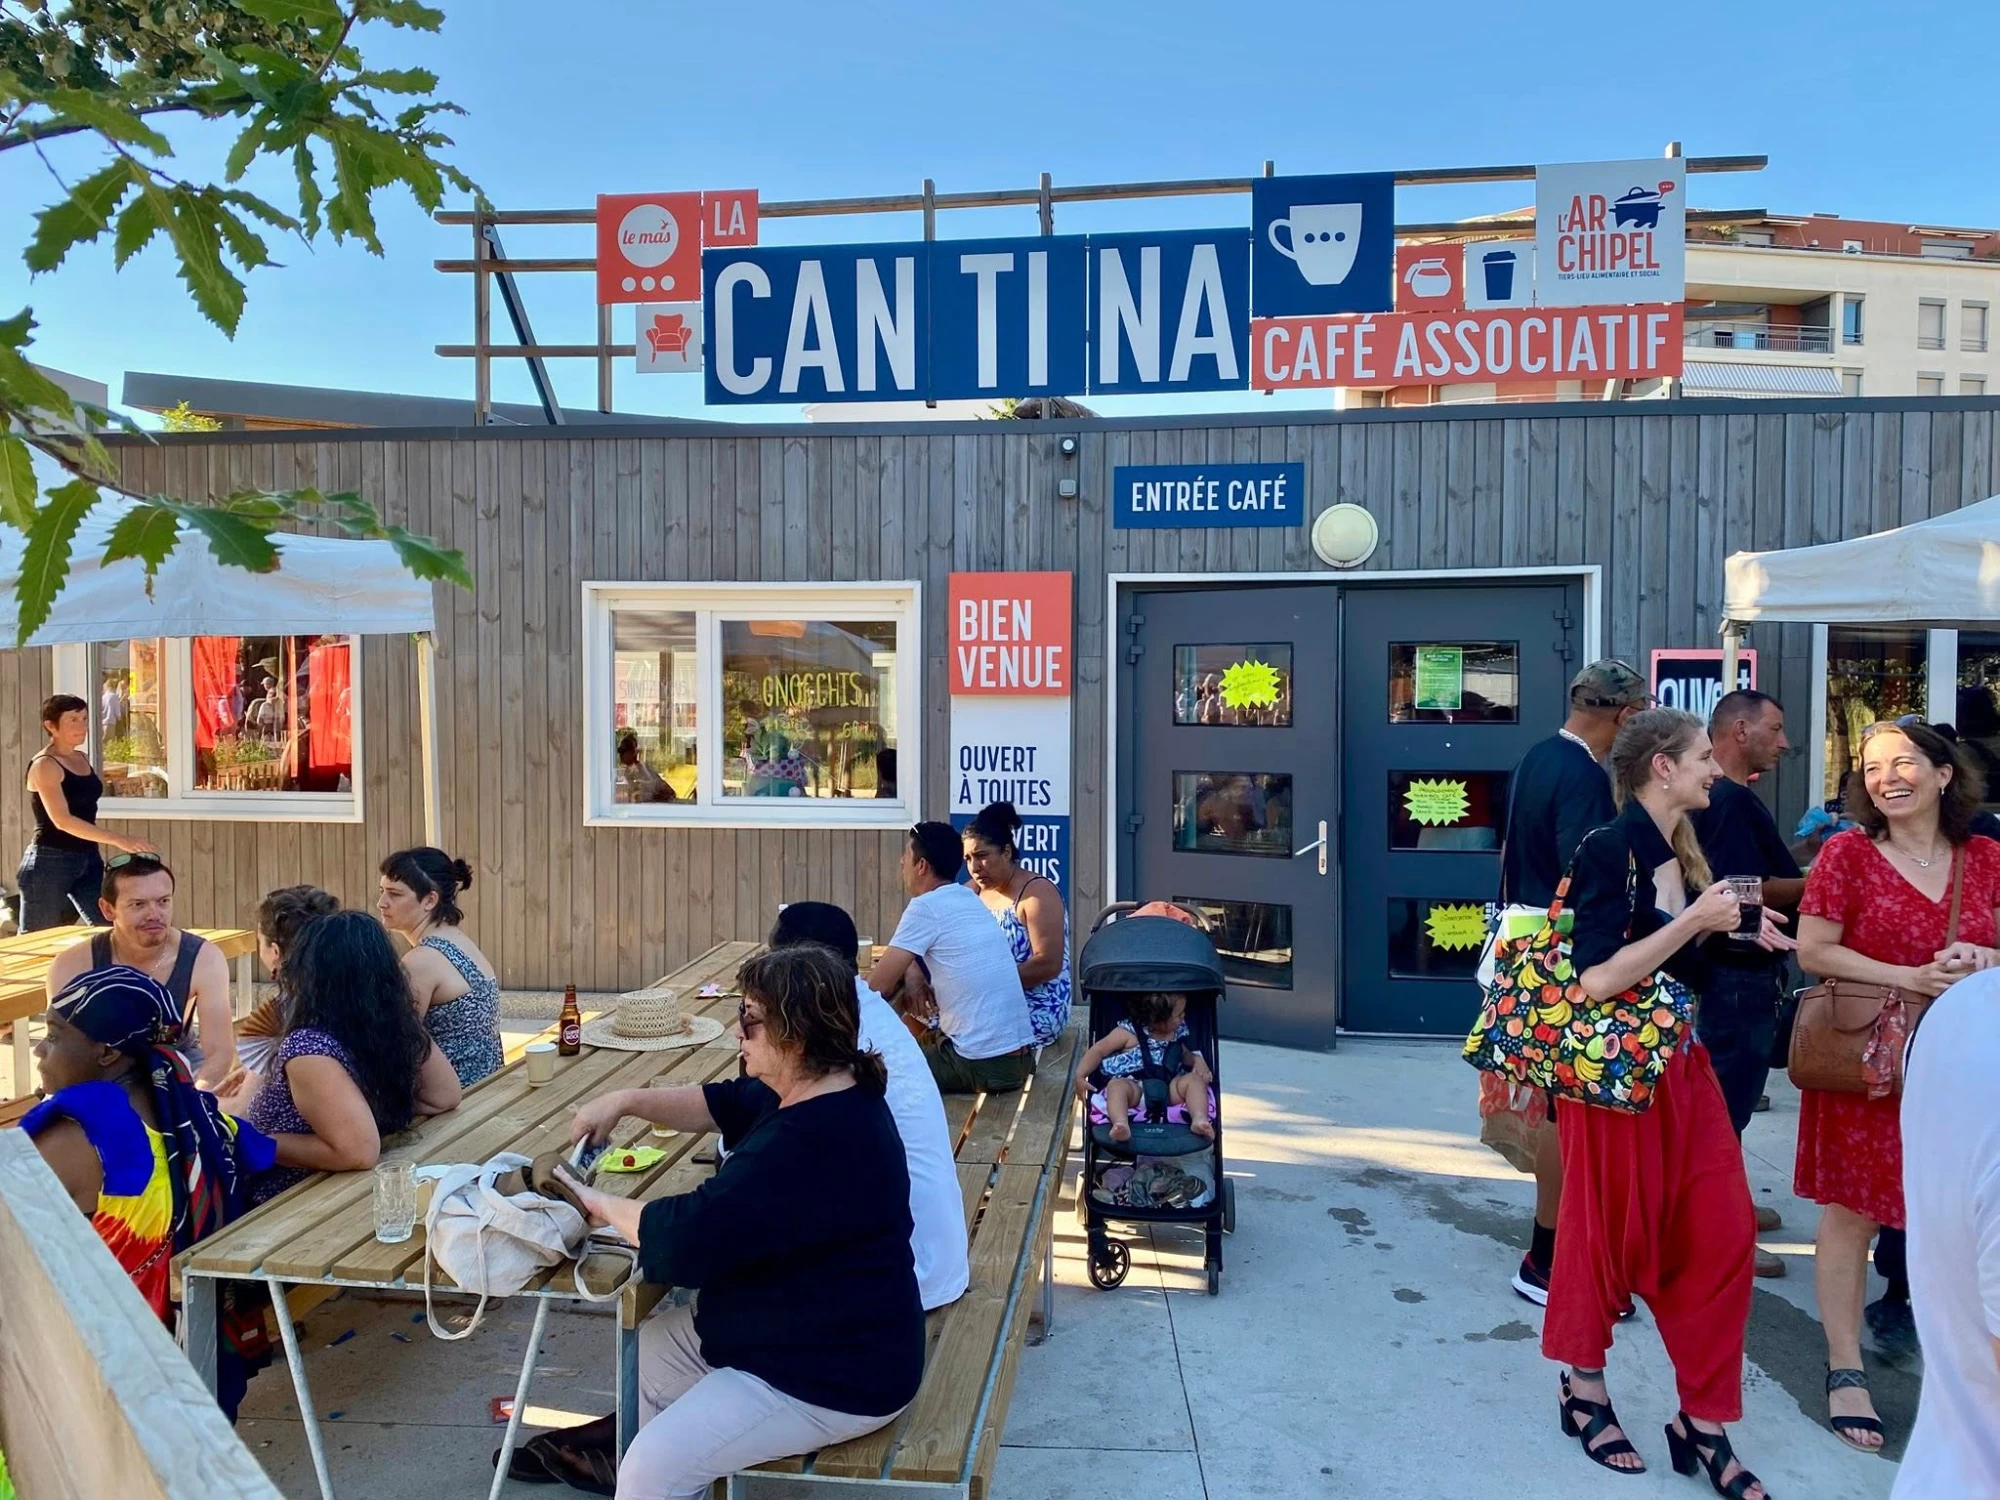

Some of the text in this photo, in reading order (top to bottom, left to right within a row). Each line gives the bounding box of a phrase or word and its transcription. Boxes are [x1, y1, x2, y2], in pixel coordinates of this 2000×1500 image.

[714, 200, 746, 236] LA
[622, 230, 671, 245] le mas
[1558, 232, 1660, 273] CHIPEL
[1558, 273, 1590, 281] TIERS-LIEU
[1591, 271, 1630, 279] ALIMENTAIRE
[714, 243, 1239, 396] CANTINA
[1264, 313, 1671, 381] CAFÉ ASSOCIATIF
[1131, 474, 1287, 512] ENTRÉE CAFÉ
[958, 599, 1032, 642] BIEN
[957, 645, 1062, 689] VENUE
[959, 745, 1037, 773] OUVERT
[958, 773, 1052, 806] À TOUTES
[1011, 824, 1060, 852] VERT
